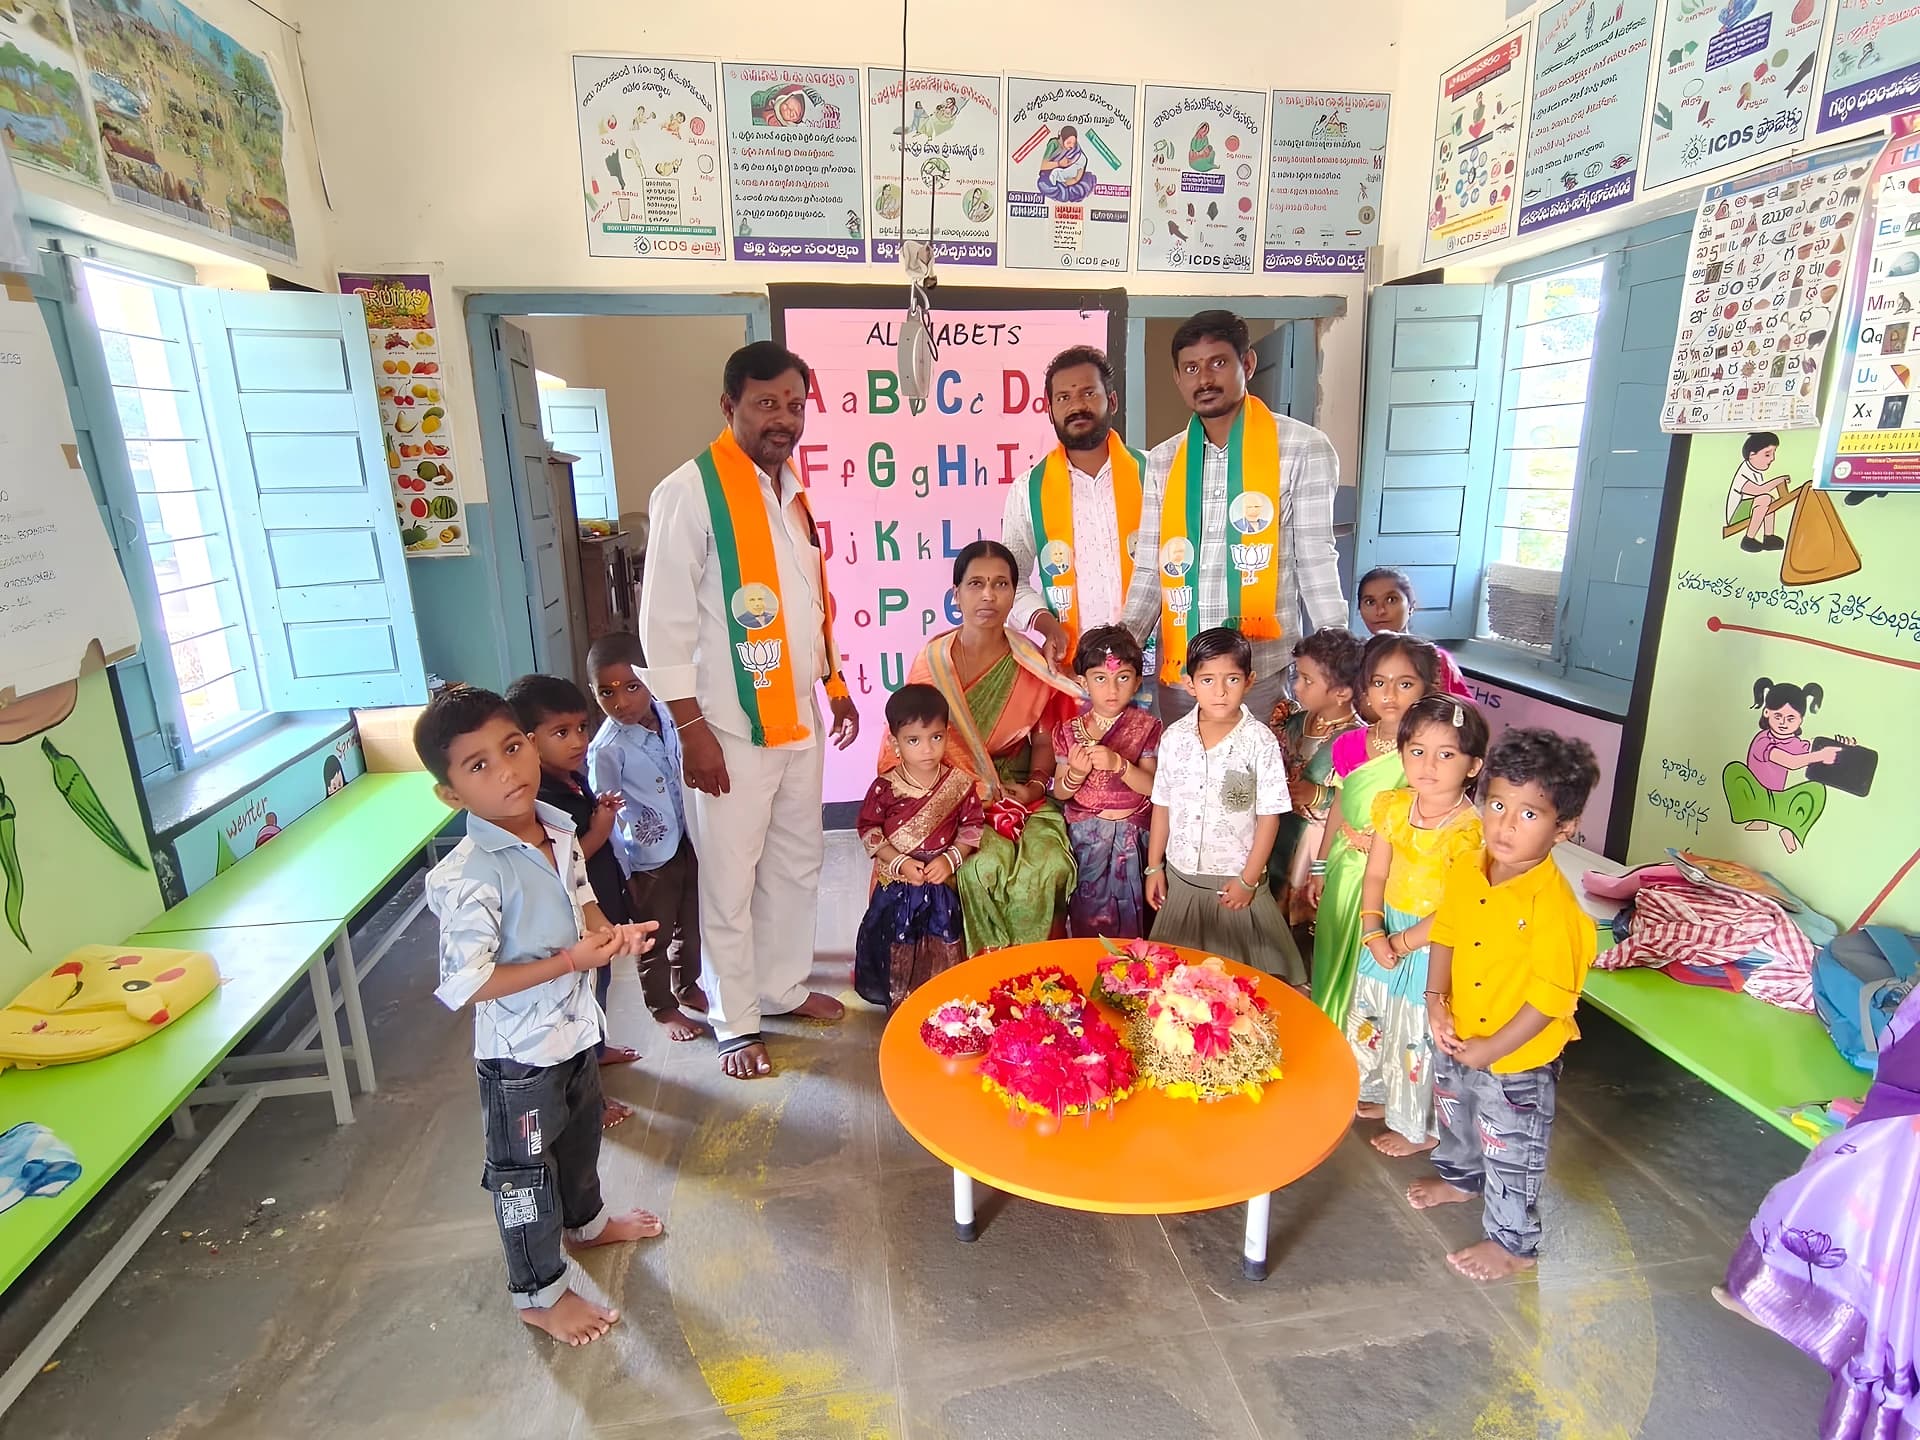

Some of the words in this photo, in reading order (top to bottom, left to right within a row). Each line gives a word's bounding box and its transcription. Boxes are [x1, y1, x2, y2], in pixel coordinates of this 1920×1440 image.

[1707, 125, 1754, 155] ICDS
[1188, 254, 1221, 266] ICDS
[1867, 294, 1895, 312] Mm
[866, 321, 1022, 348] ALABETS
[1861, 327, 1883, 345] Qq
[1857, 367, 1878, 384] Uu
[806, 368, 827, 413] A
[842, 391, 858, 414] a
[867, 369, 900, 414] B
[936, 369, 963, 415] C
[970, 392, 984, 414] c
[1003, 369, 1030, 414] D
[1852, 402, 1873, 419] Xx
[799, 444, 829, 489] F
[840, 458, 856, 488] f
[867, 442, 896, 488] G
[911, 465, 930, 498] g
[937, 445, 967, 487] H
[974, 458, 988, 487] h
[997, 443, 1020, 484] I
[816, 520, 834, 562] J
[846, 531, 858, 565] j
[875, 520, 901, 562] K
[917, 532, 932, 561] k
[942, 519, 964, 559] L
[879, 588, 909, 627] P
[922, 609, 937, 636] p
[857, 663, 873, 695] t
[880, 652, 905, 693] U
[530, 1128, 543, 1156] ONE
